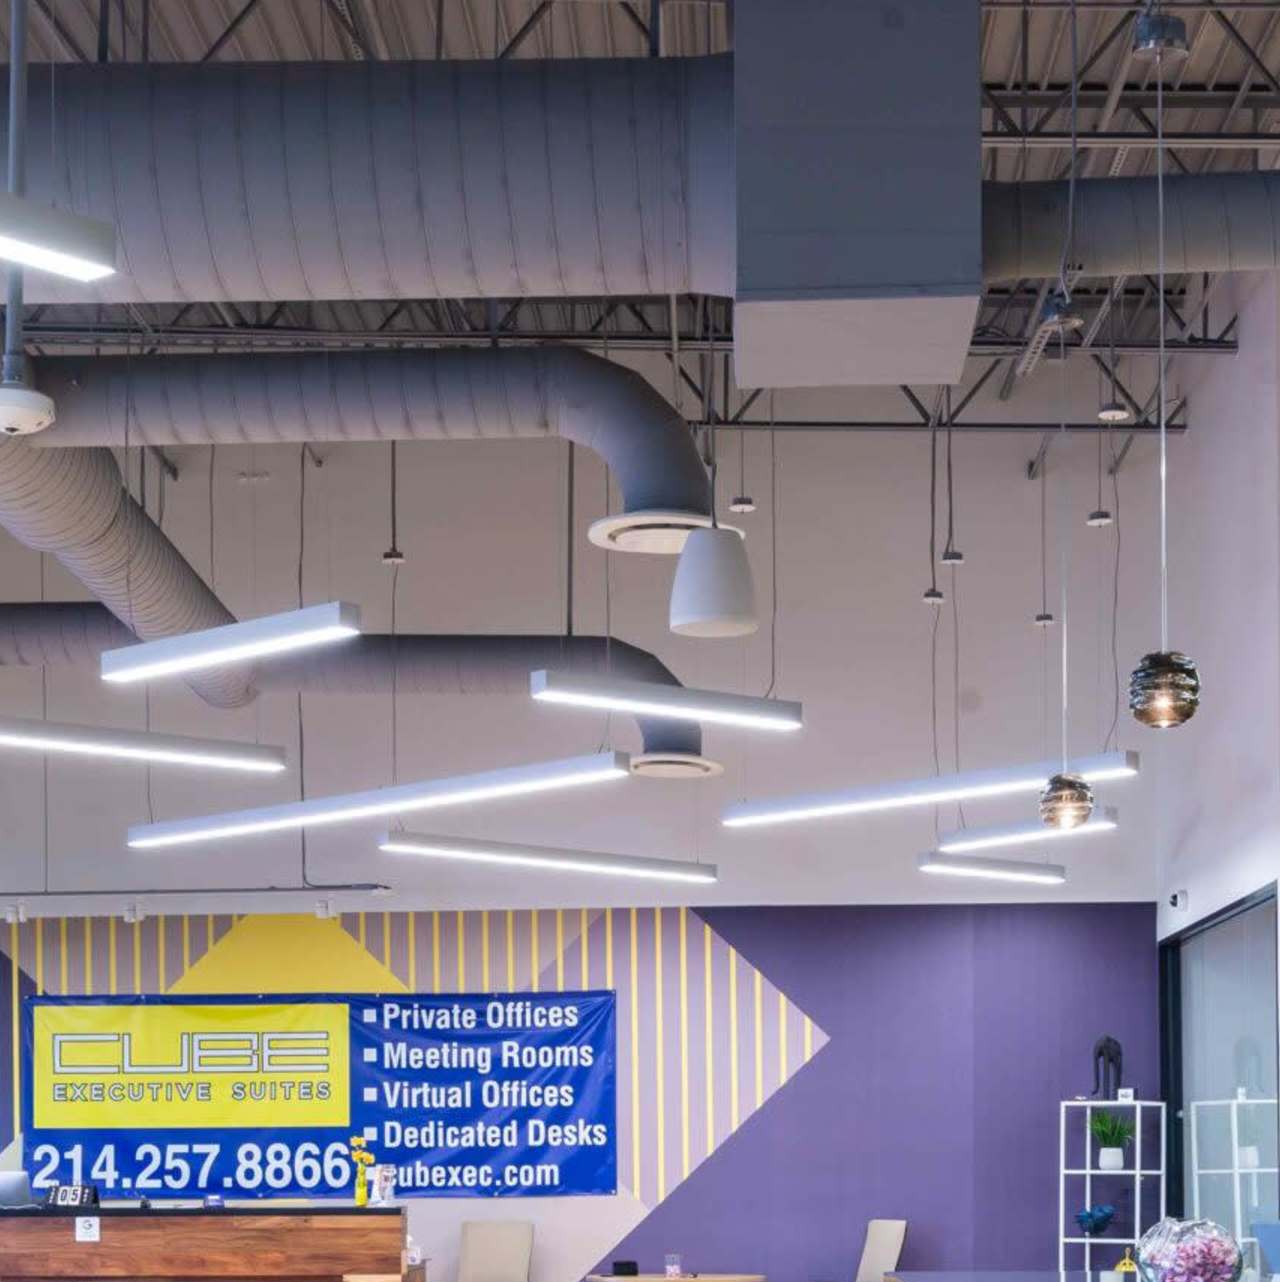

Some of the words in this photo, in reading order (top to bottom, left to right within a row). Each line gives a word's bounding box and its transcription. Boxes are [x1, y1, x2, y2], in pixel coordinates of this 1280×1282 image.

[383, 1004, 477, 1030] Private
[486, 1001, 579, 1028] Offices
[52, 1032, 329, 1074] CUBE
[383, 1042, 492, 1074] Meeting
[501, 1041, 594, 1068] Rooms
[52, 1083, 211, 1102] EXECUTIVE
[232, 1081, 331, 1100] SUITES
[383, 1081, 472, 1108] Virtual
[482, 1080, 575, 1107] Offices
[384, 1120, 518, 1149] Dedicated
[527, 1118, 608, 1146] Desks
[32, 1143, 351, 1189] 214.257.8866
